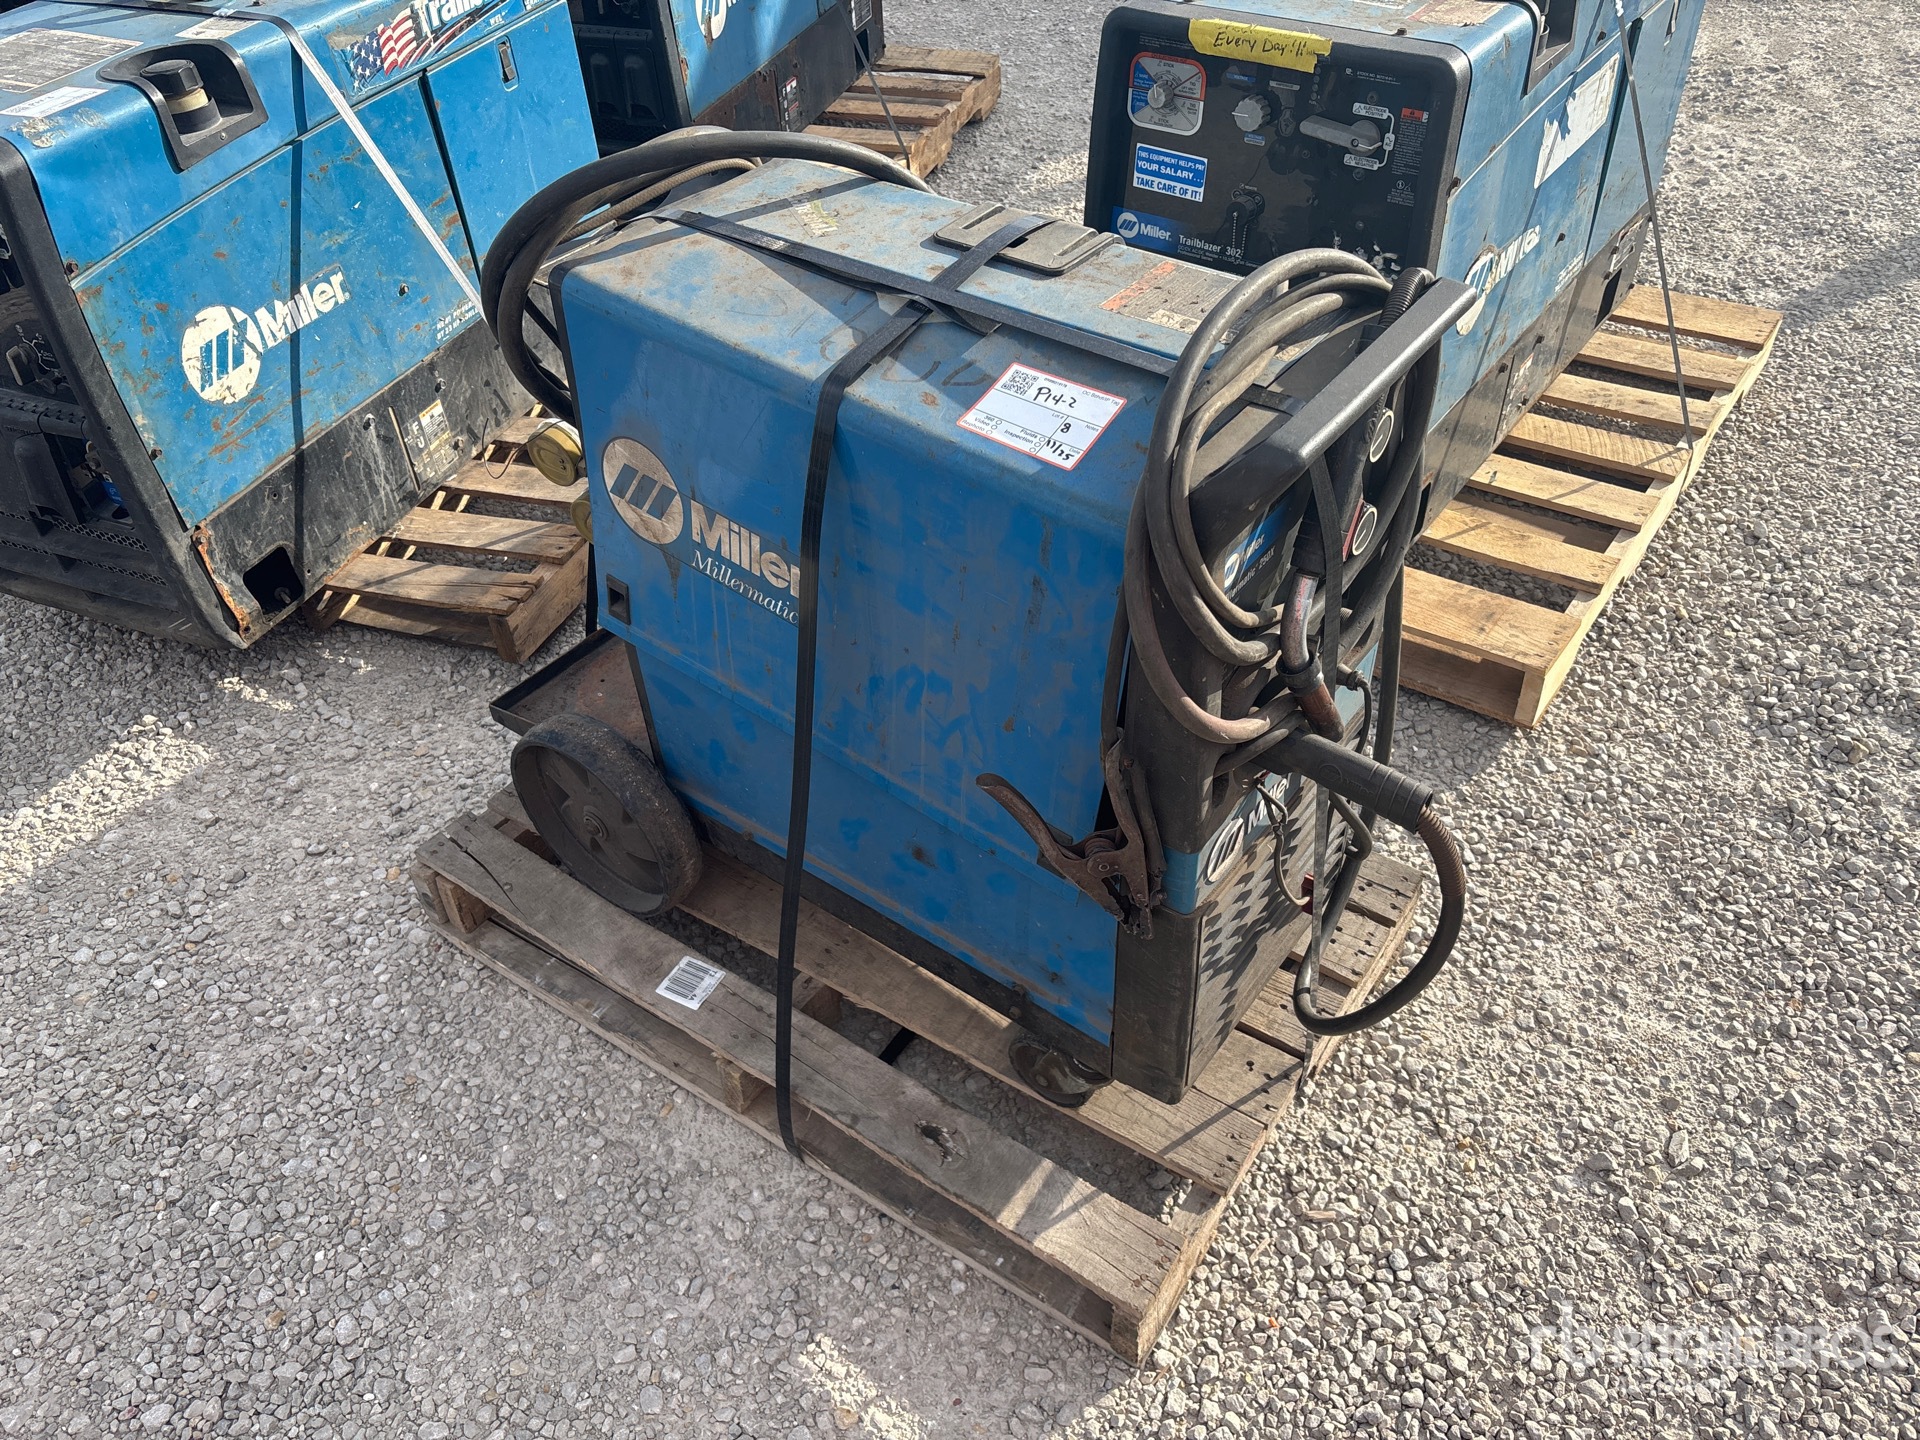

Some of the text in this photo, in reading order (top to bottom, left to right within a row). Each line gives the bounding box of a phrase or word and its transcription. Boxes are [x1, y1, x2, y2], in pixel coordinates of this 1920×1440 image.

[1213, 31, 1257, 52] Every
[1365, 110, 1384, 118] POSITIVE
[1137, 160, 1158, 172] YOUR
[1138, 150, 1205, 171] THIS EQUIPMENT HELPS PAY
[1136, 176, 1201, 200] TAKE CARE OF IT!
[1140, 223, 1171, 241] Miller
[1179, 234, 1241, 258] Trailblazer 302
[254, 270, 345, 350] Miller
[1033, 386, 1077, 409] P14-2
[962, 419, 985, 432] Rephoto
[974, 417, 990, 427] Video
[984, 414, 995, 422] 360
[1020, 428, 1038, 439] Fluids
[1060, 422, 1071, 434] 8
[1084, 423, 1099, 432] Notes
[1004, 429, 1034, 444] Inspection
[691, 549, 799, 624] Millermatic
